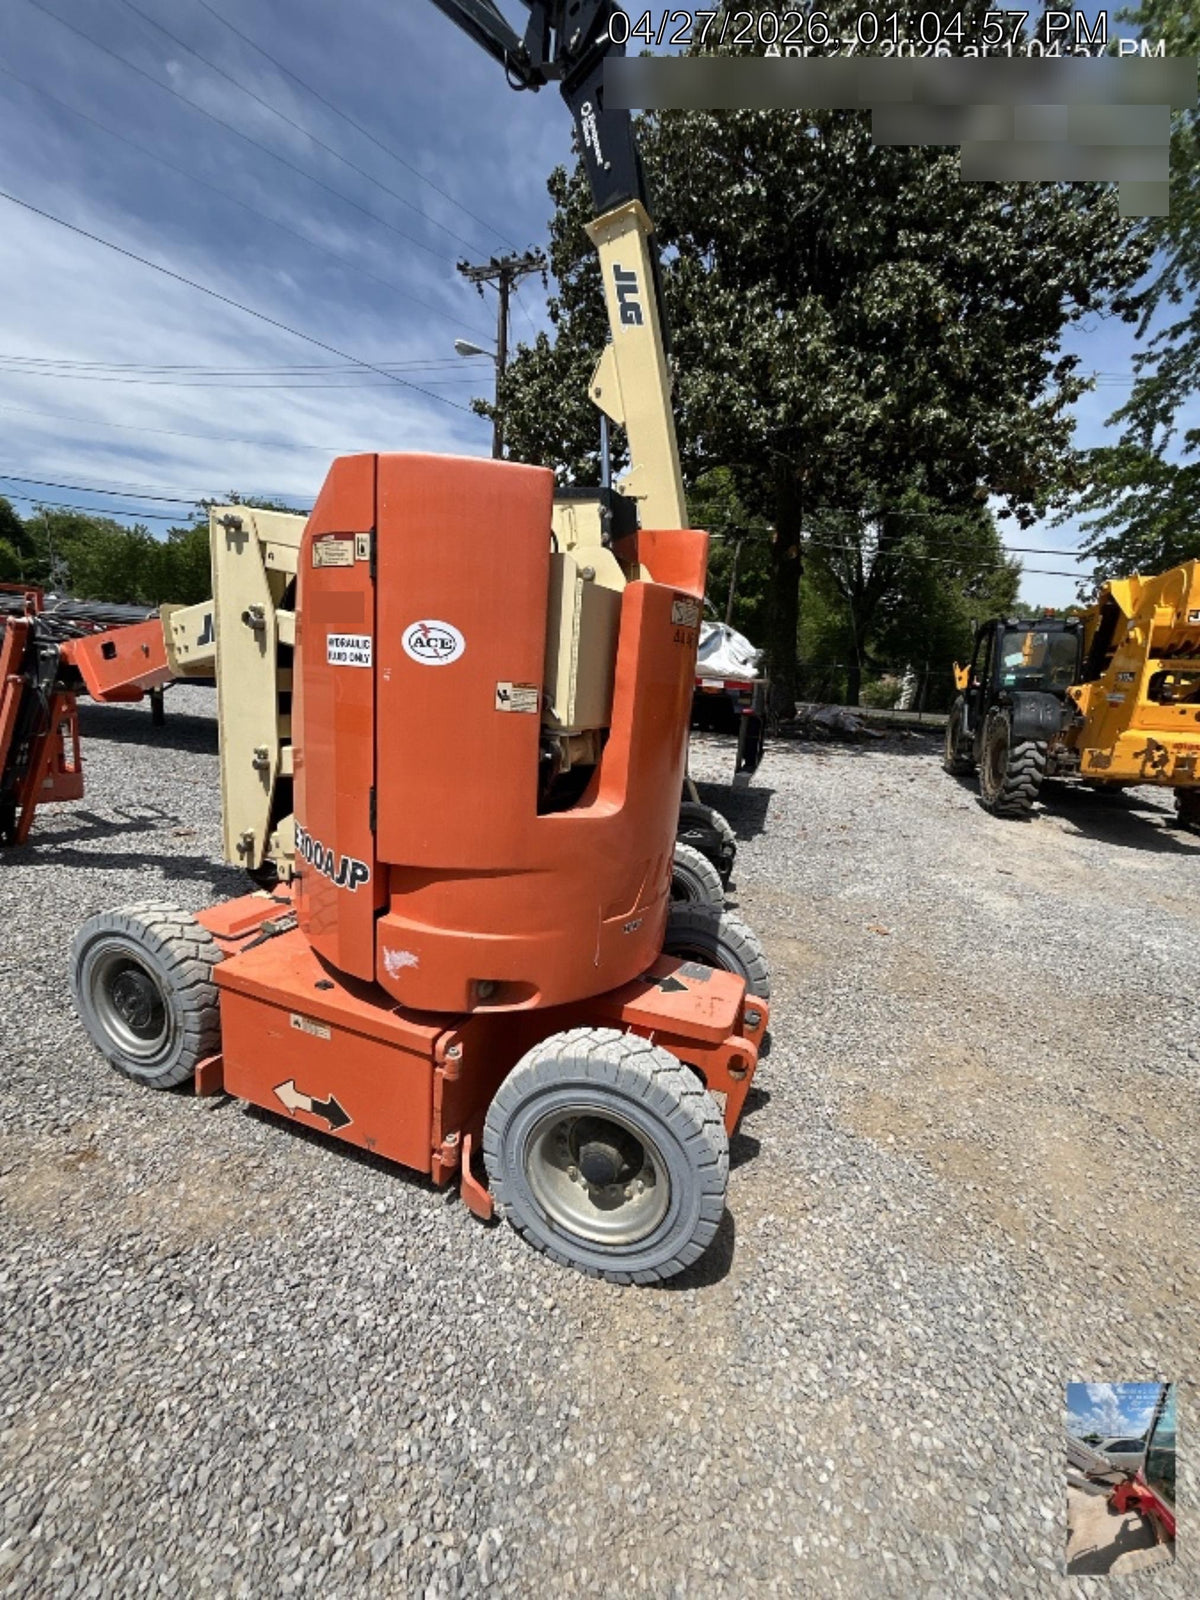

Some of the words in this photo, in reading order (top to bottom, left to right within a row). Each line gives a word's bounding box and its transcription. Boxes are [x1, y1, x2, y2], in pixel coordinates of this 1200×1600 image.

[612, 263, 644, 326] JLG
[413, 636, 453, 650] ACE
[349, 652, 371, 664] ONLY
